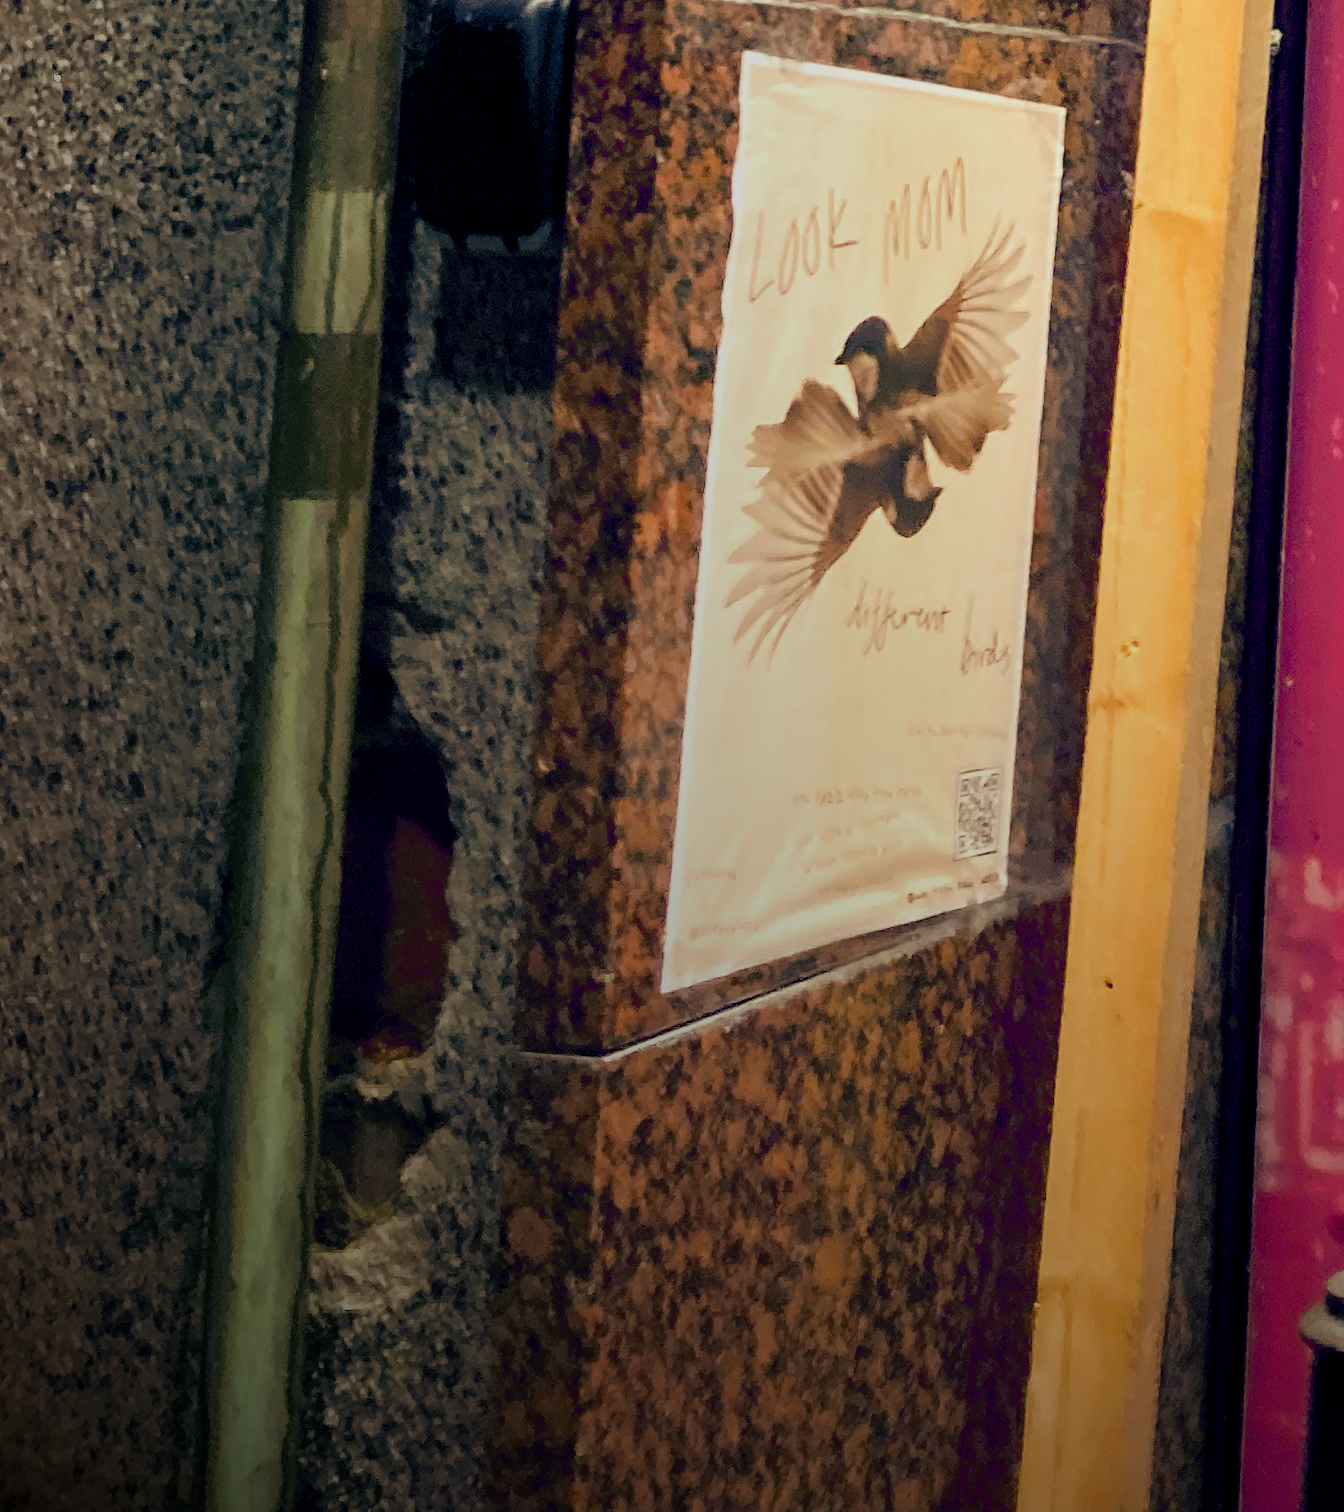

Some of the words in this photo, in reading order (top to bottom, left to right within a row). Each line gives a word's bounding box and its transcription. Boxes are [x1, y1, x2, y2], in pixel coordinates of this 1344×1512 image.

[748, 188, 858, 304] LOOK
[883, 156, 968, 285] MOM
[845, 576, 954, 659] different
